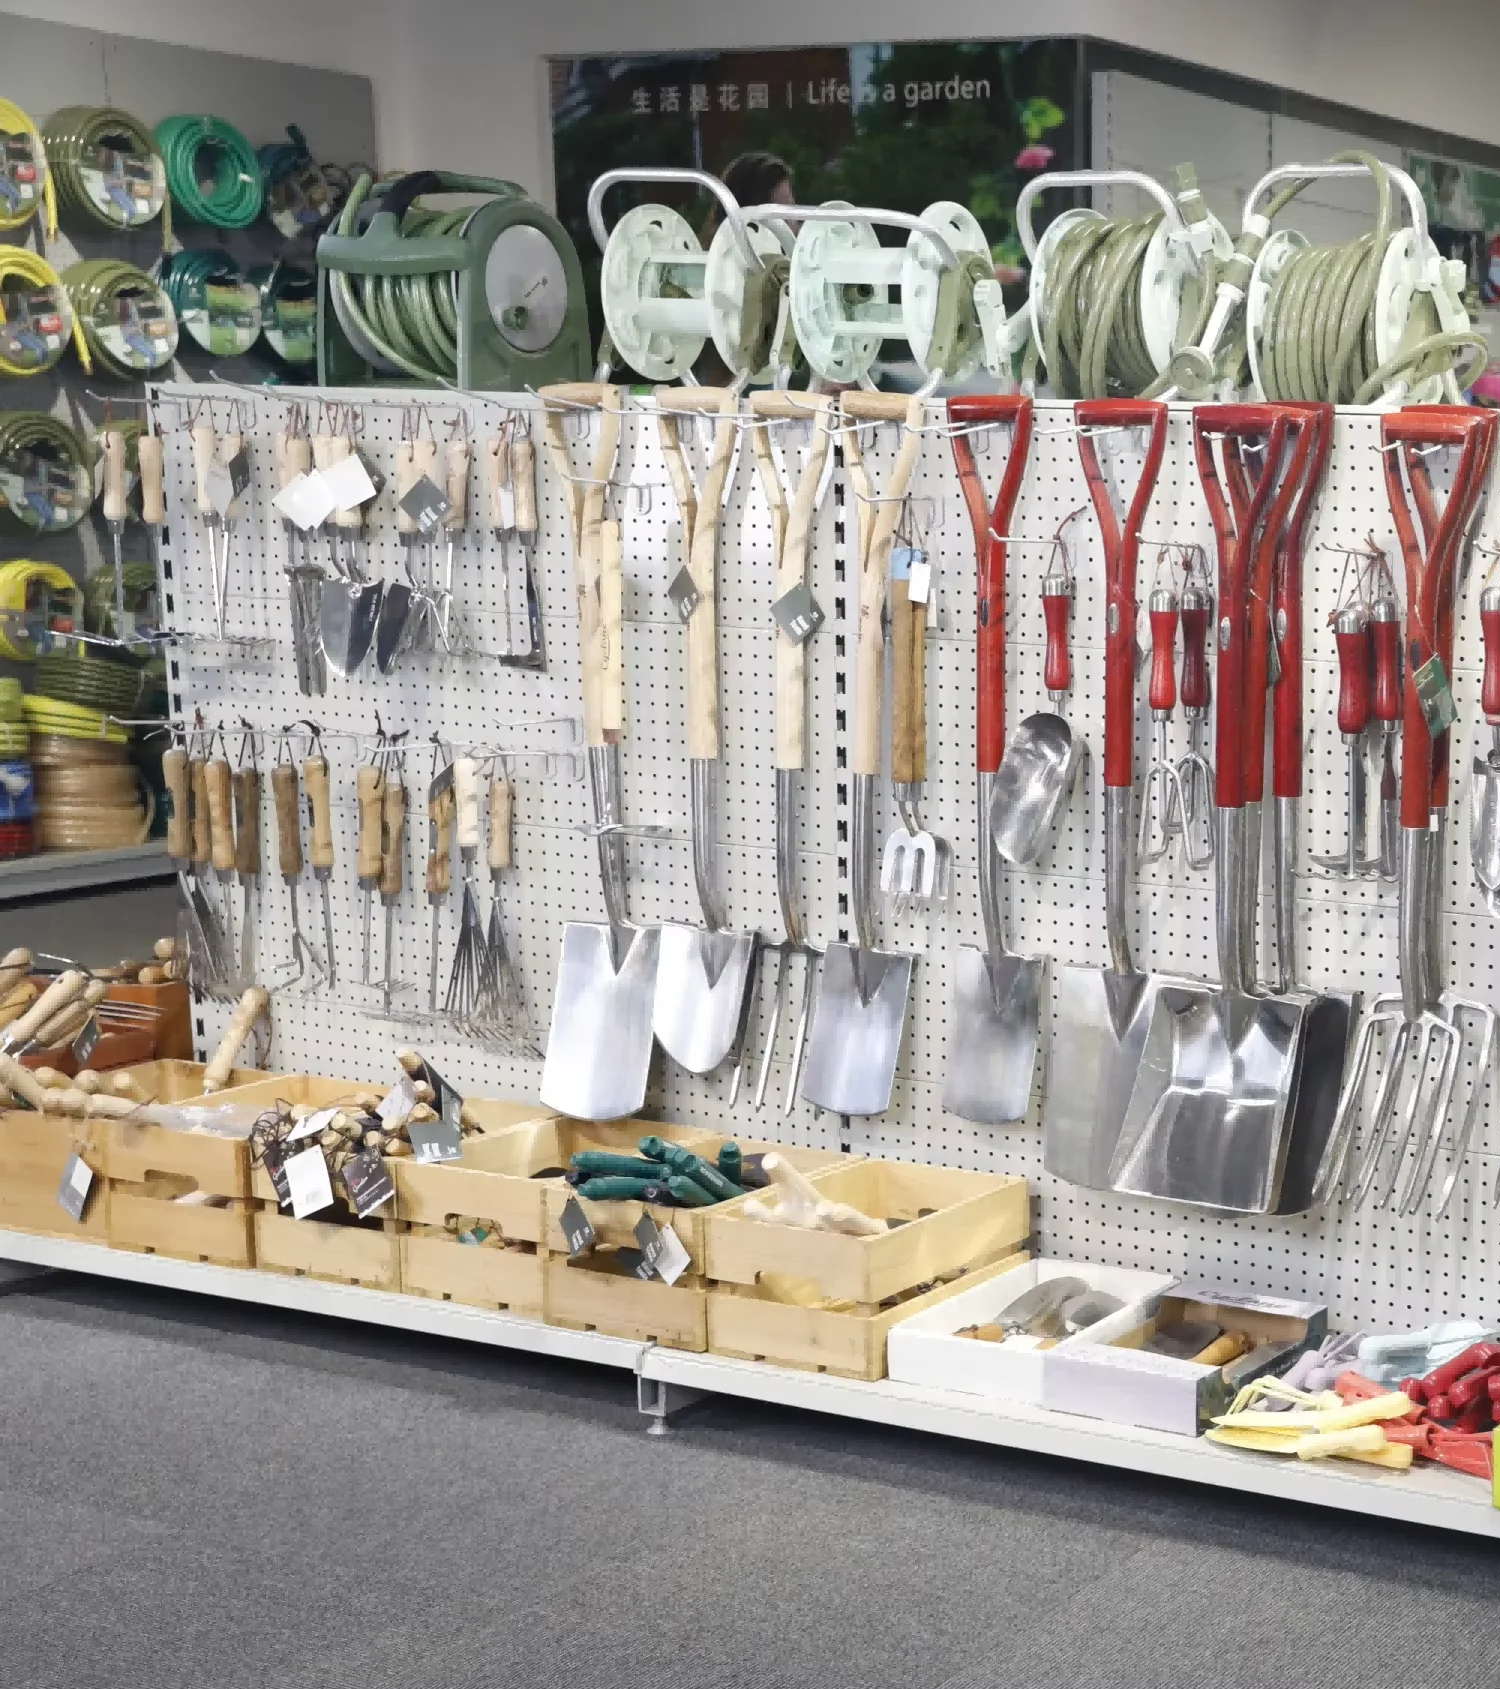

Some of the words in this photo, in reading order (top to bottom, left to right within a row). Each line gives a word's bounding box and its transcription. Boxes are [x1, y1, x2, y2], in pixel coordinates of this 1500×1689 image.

[631, 83, 769, 114] 生活是花园
[807, 78, 850, 105] Life
[882, 83, 896, 103] a
[904, 73, 991, 108] garden
